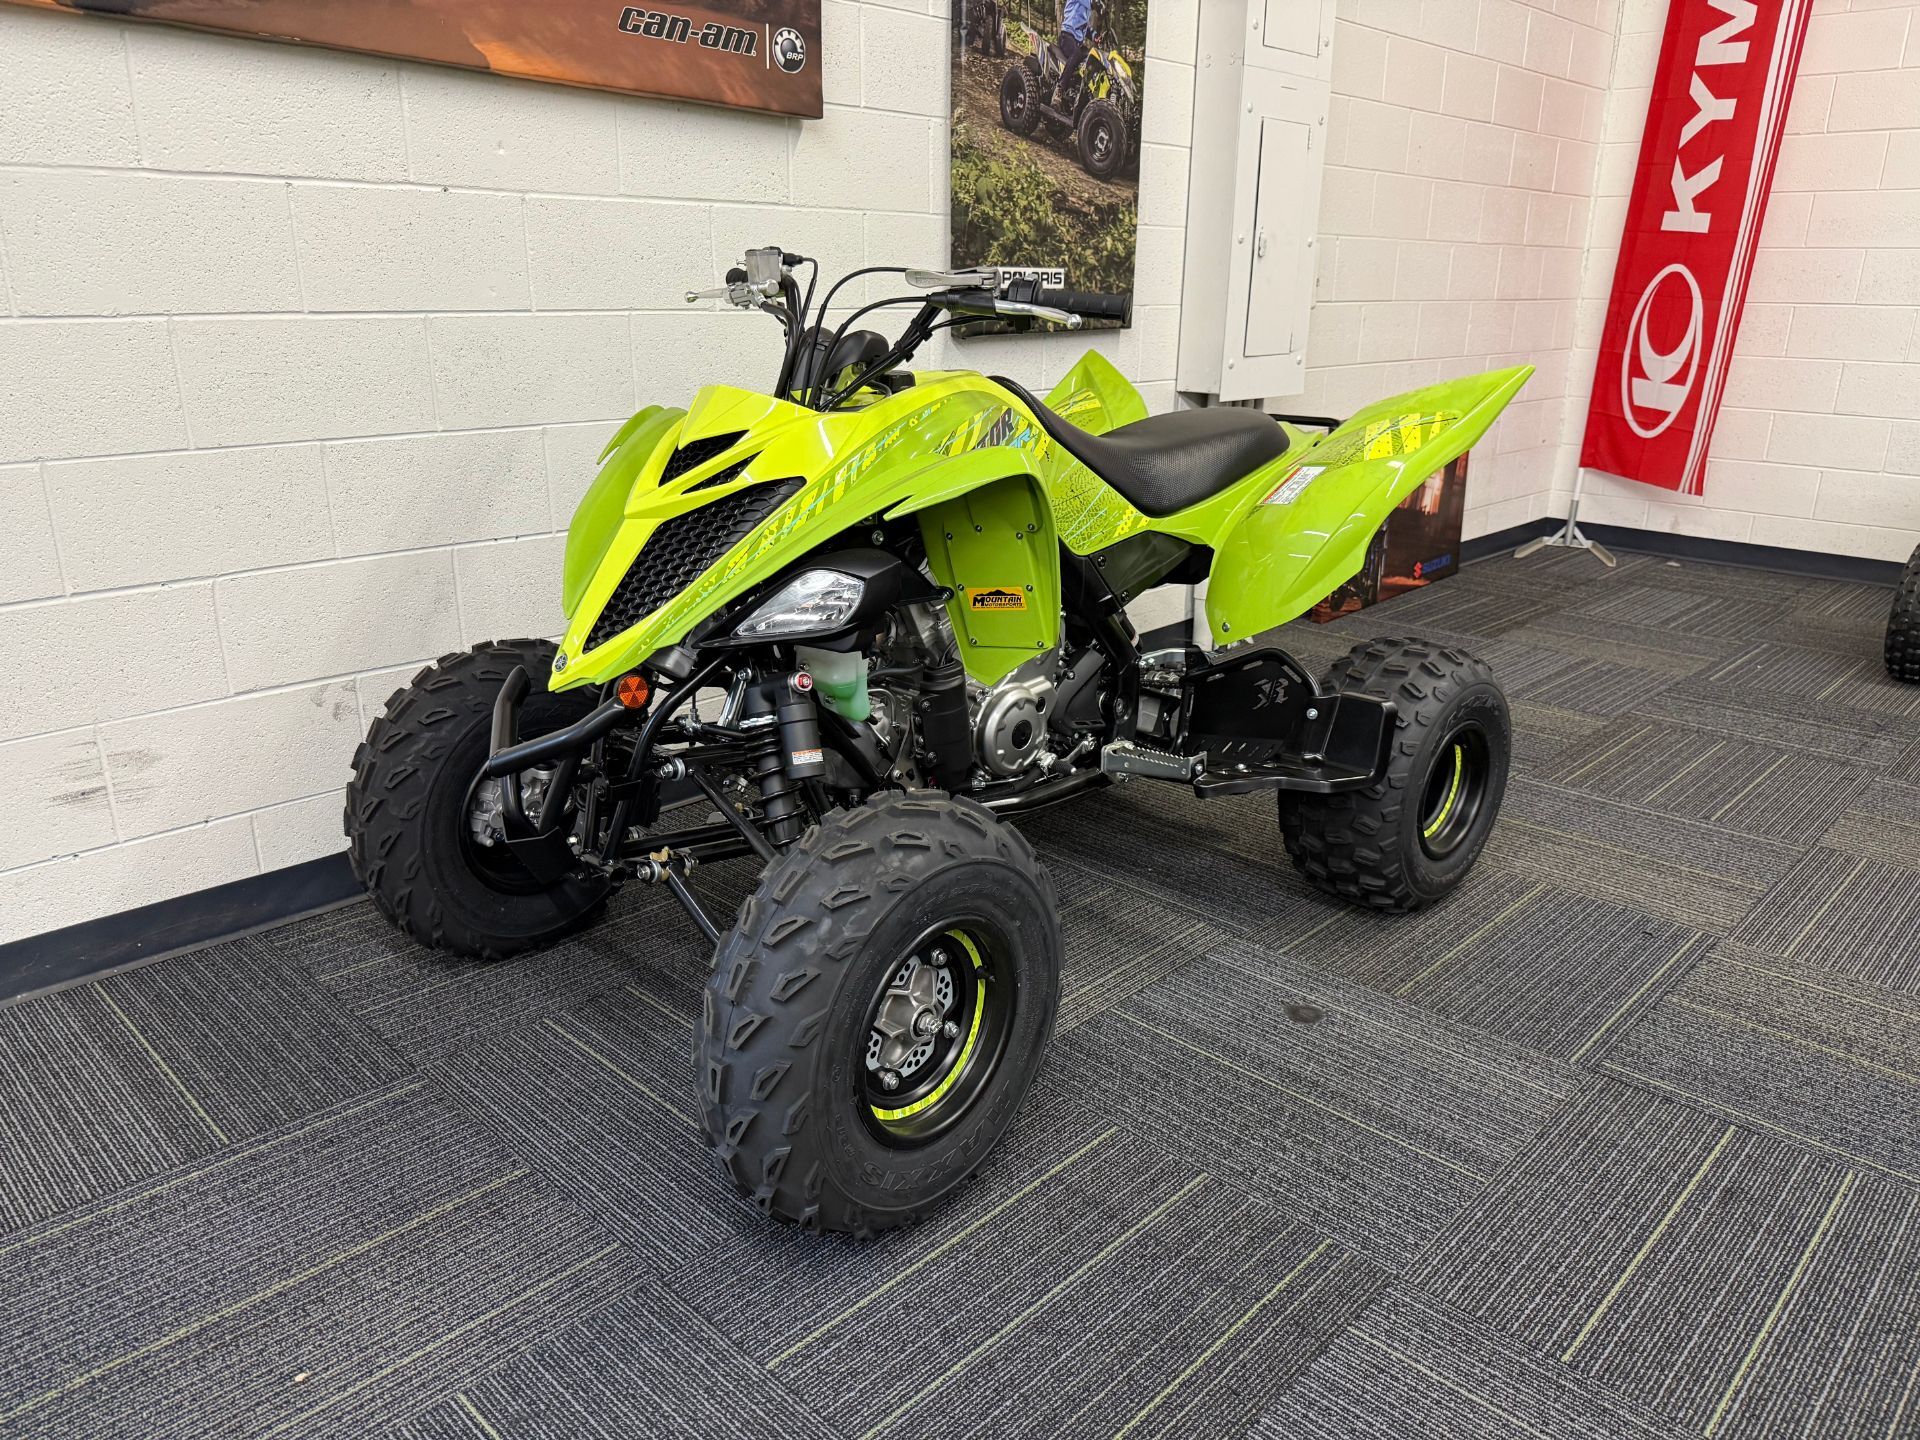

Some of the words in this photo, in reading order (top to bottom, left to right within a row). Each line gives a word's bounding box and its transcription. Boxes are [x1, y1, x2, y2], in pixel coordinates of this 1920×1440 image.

[618, 6, 758, 57] can-am
[786, 51, 804, 61] BRP
[972, 596, 1023, 607] MOUNTAIN
